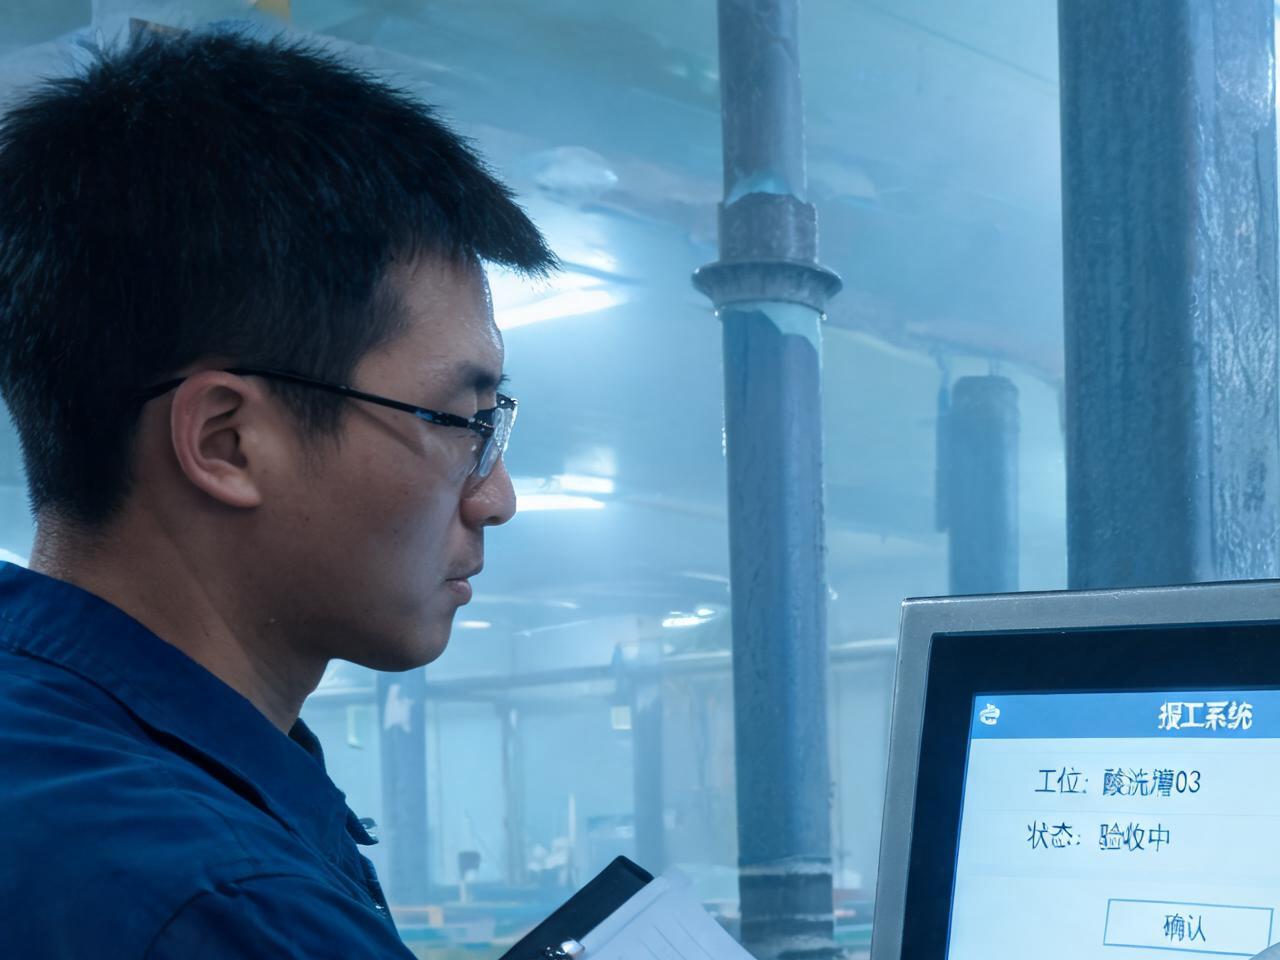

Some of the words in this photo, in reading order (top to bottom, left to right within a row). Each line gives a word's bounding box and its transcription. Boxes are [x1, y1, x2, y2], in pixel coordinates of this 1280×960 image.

[1158, 700, 1253, 730] 报工系统
[1163, 912, 1206, 942] 确认
